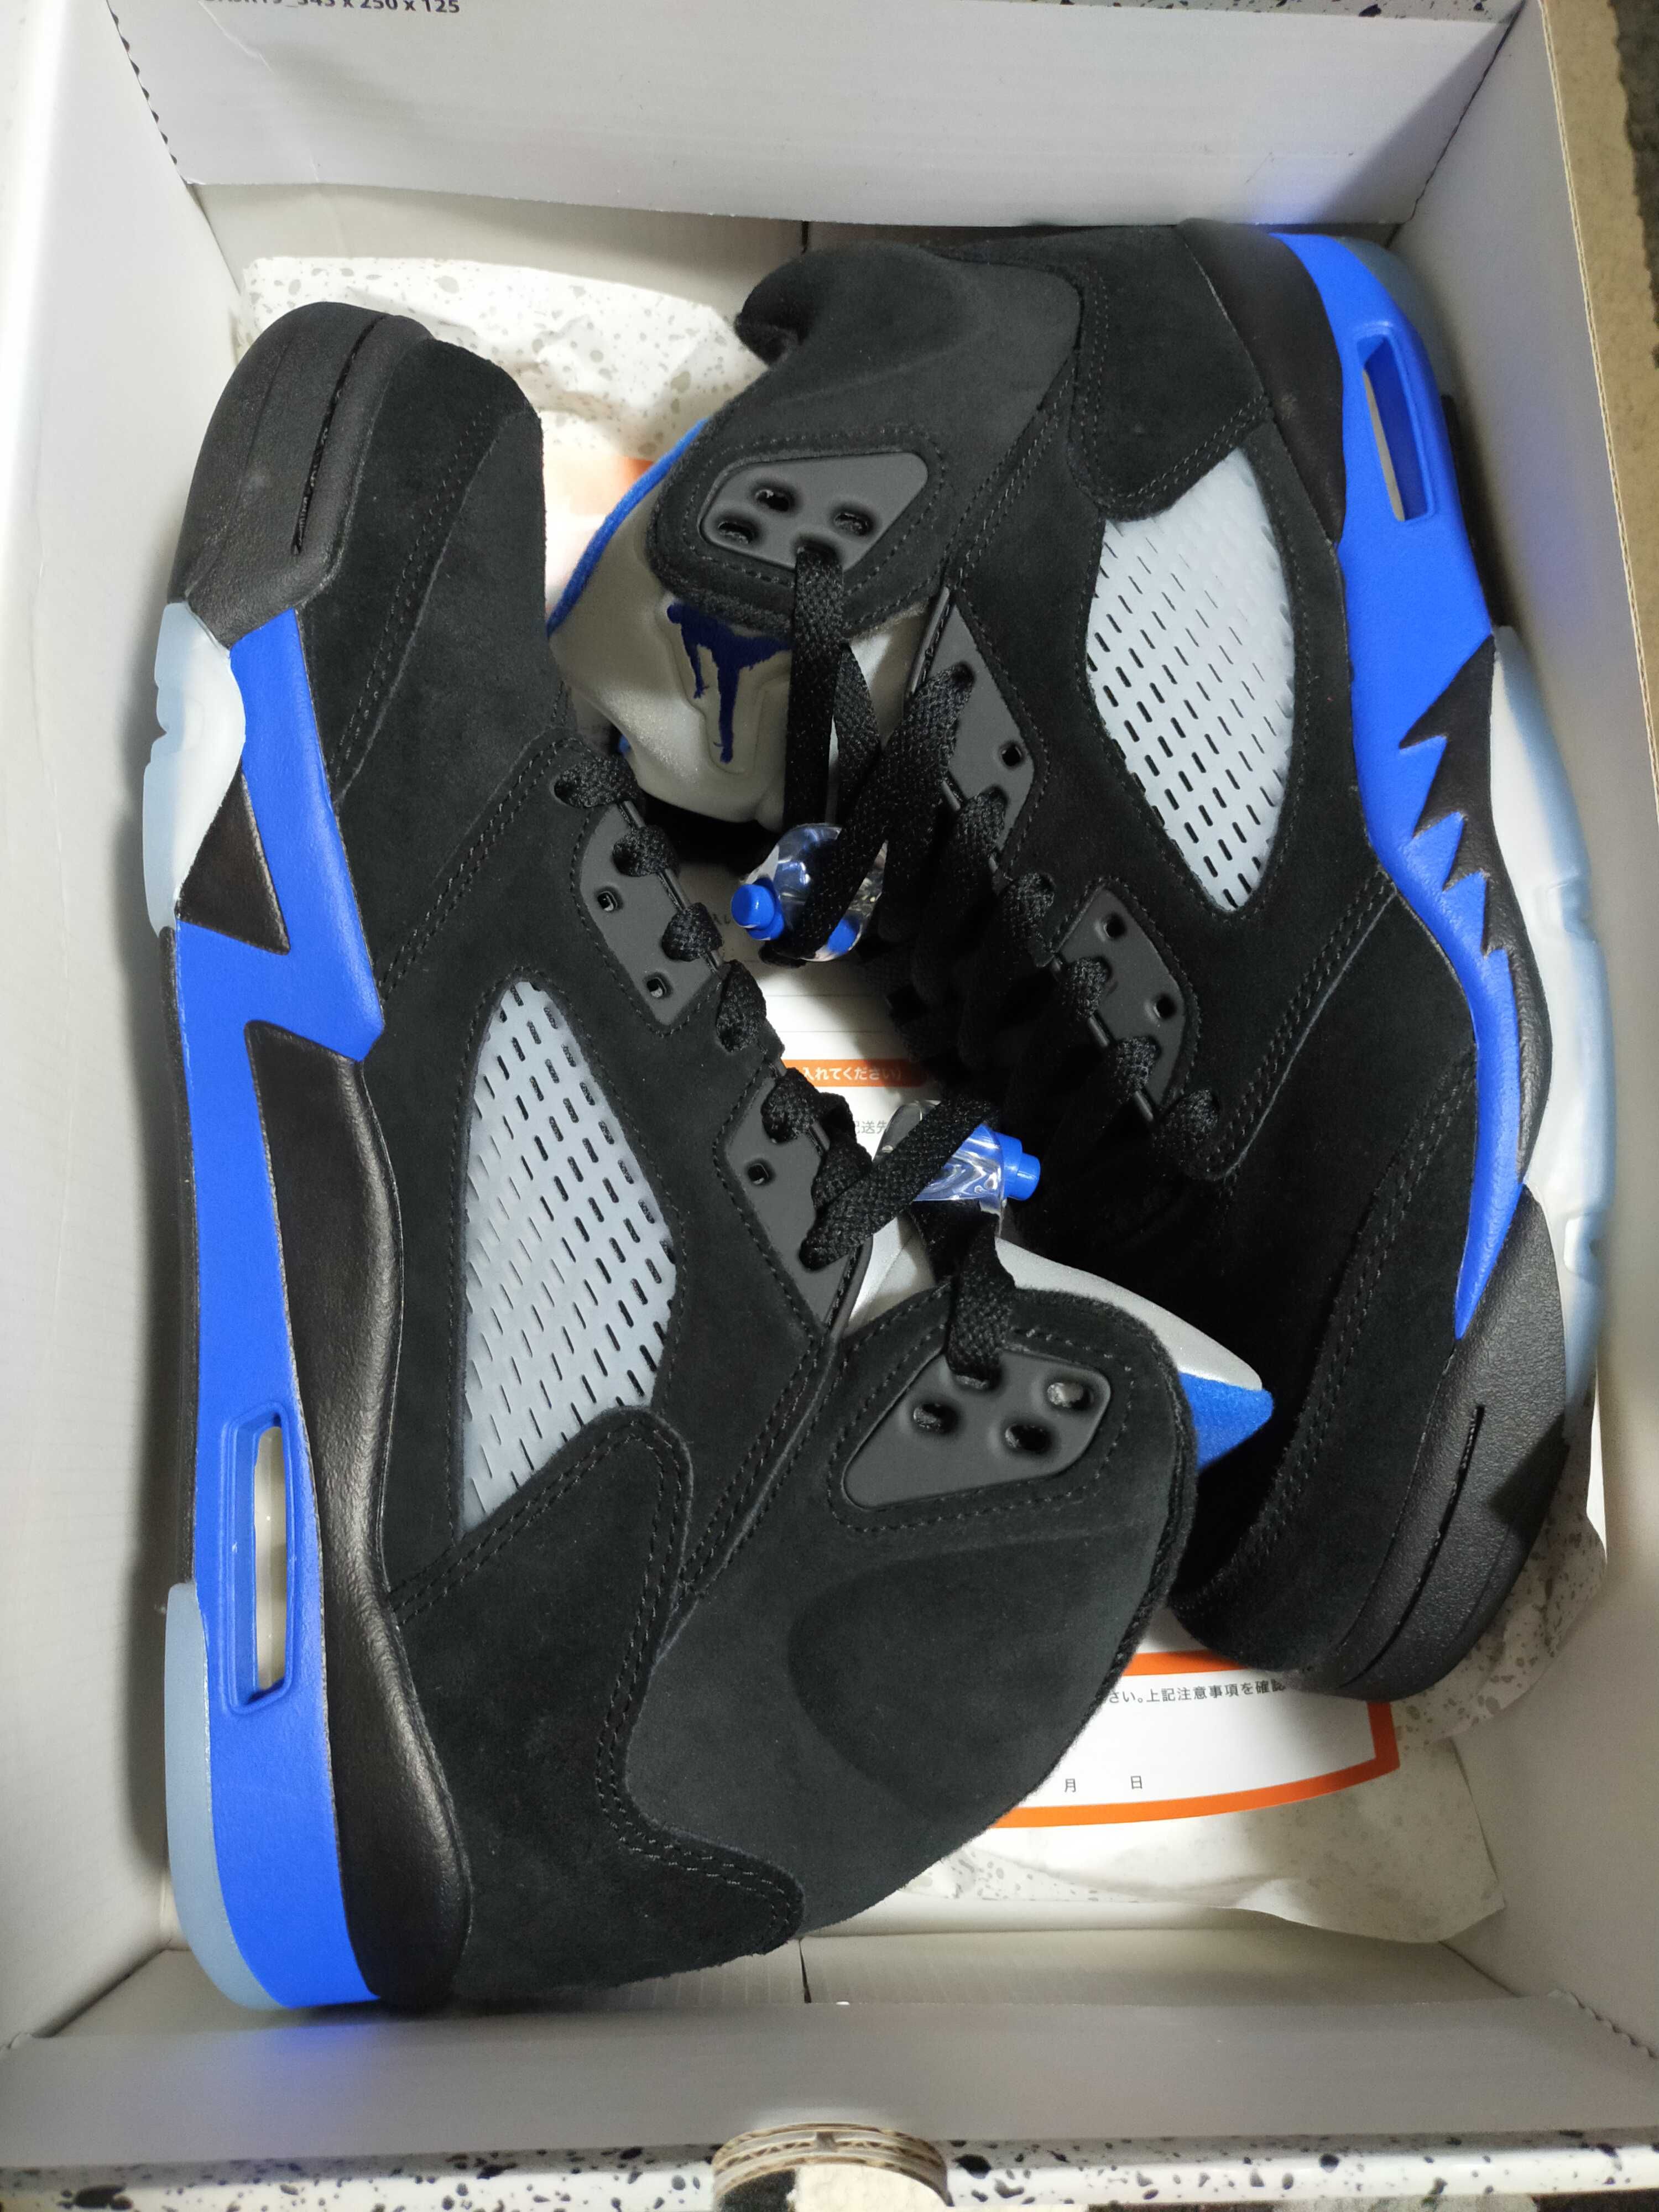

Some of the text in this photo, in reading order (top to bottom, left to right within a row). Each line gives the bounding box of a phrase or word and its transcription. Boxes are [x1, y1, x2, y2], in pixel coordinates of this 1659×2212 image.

[404, 1, 416, 12] x
[421, 0, 460, 13] 125
[1064, 1775, 1143, 1793] 月 日
